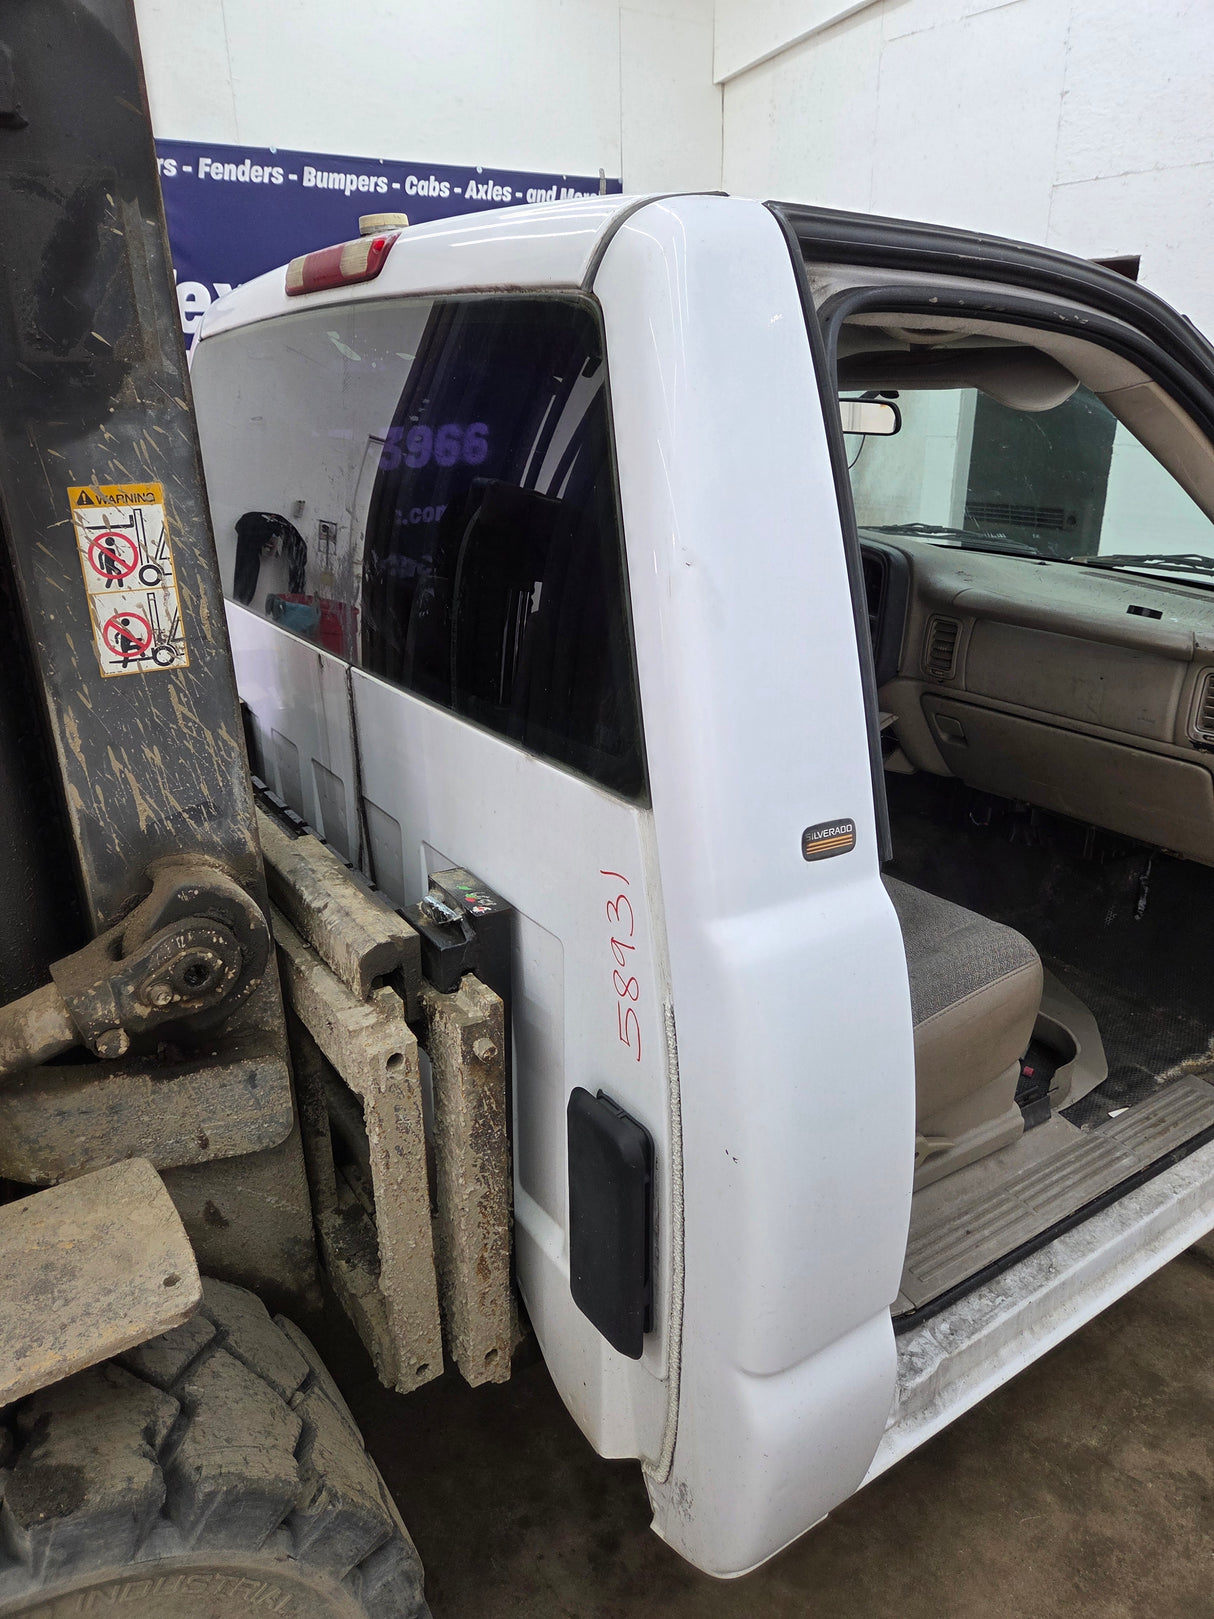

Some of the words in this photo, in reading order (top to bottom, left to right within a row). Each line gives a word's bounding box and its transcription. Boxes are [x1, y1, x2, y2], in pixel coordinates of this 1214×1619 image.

[198, 157, 284, 184] Fenders
[303, 166, 388, 194] Bumpers
[405, 175, 449, 198] Cabs
[465, 179, 511, 203] Axles
[526, 185, 557, 204] and
[95, 491, 155, 506] WARNING
[805, 824, 853, 841] SILVERADO
[600, 870, 641, 1062] 58931
